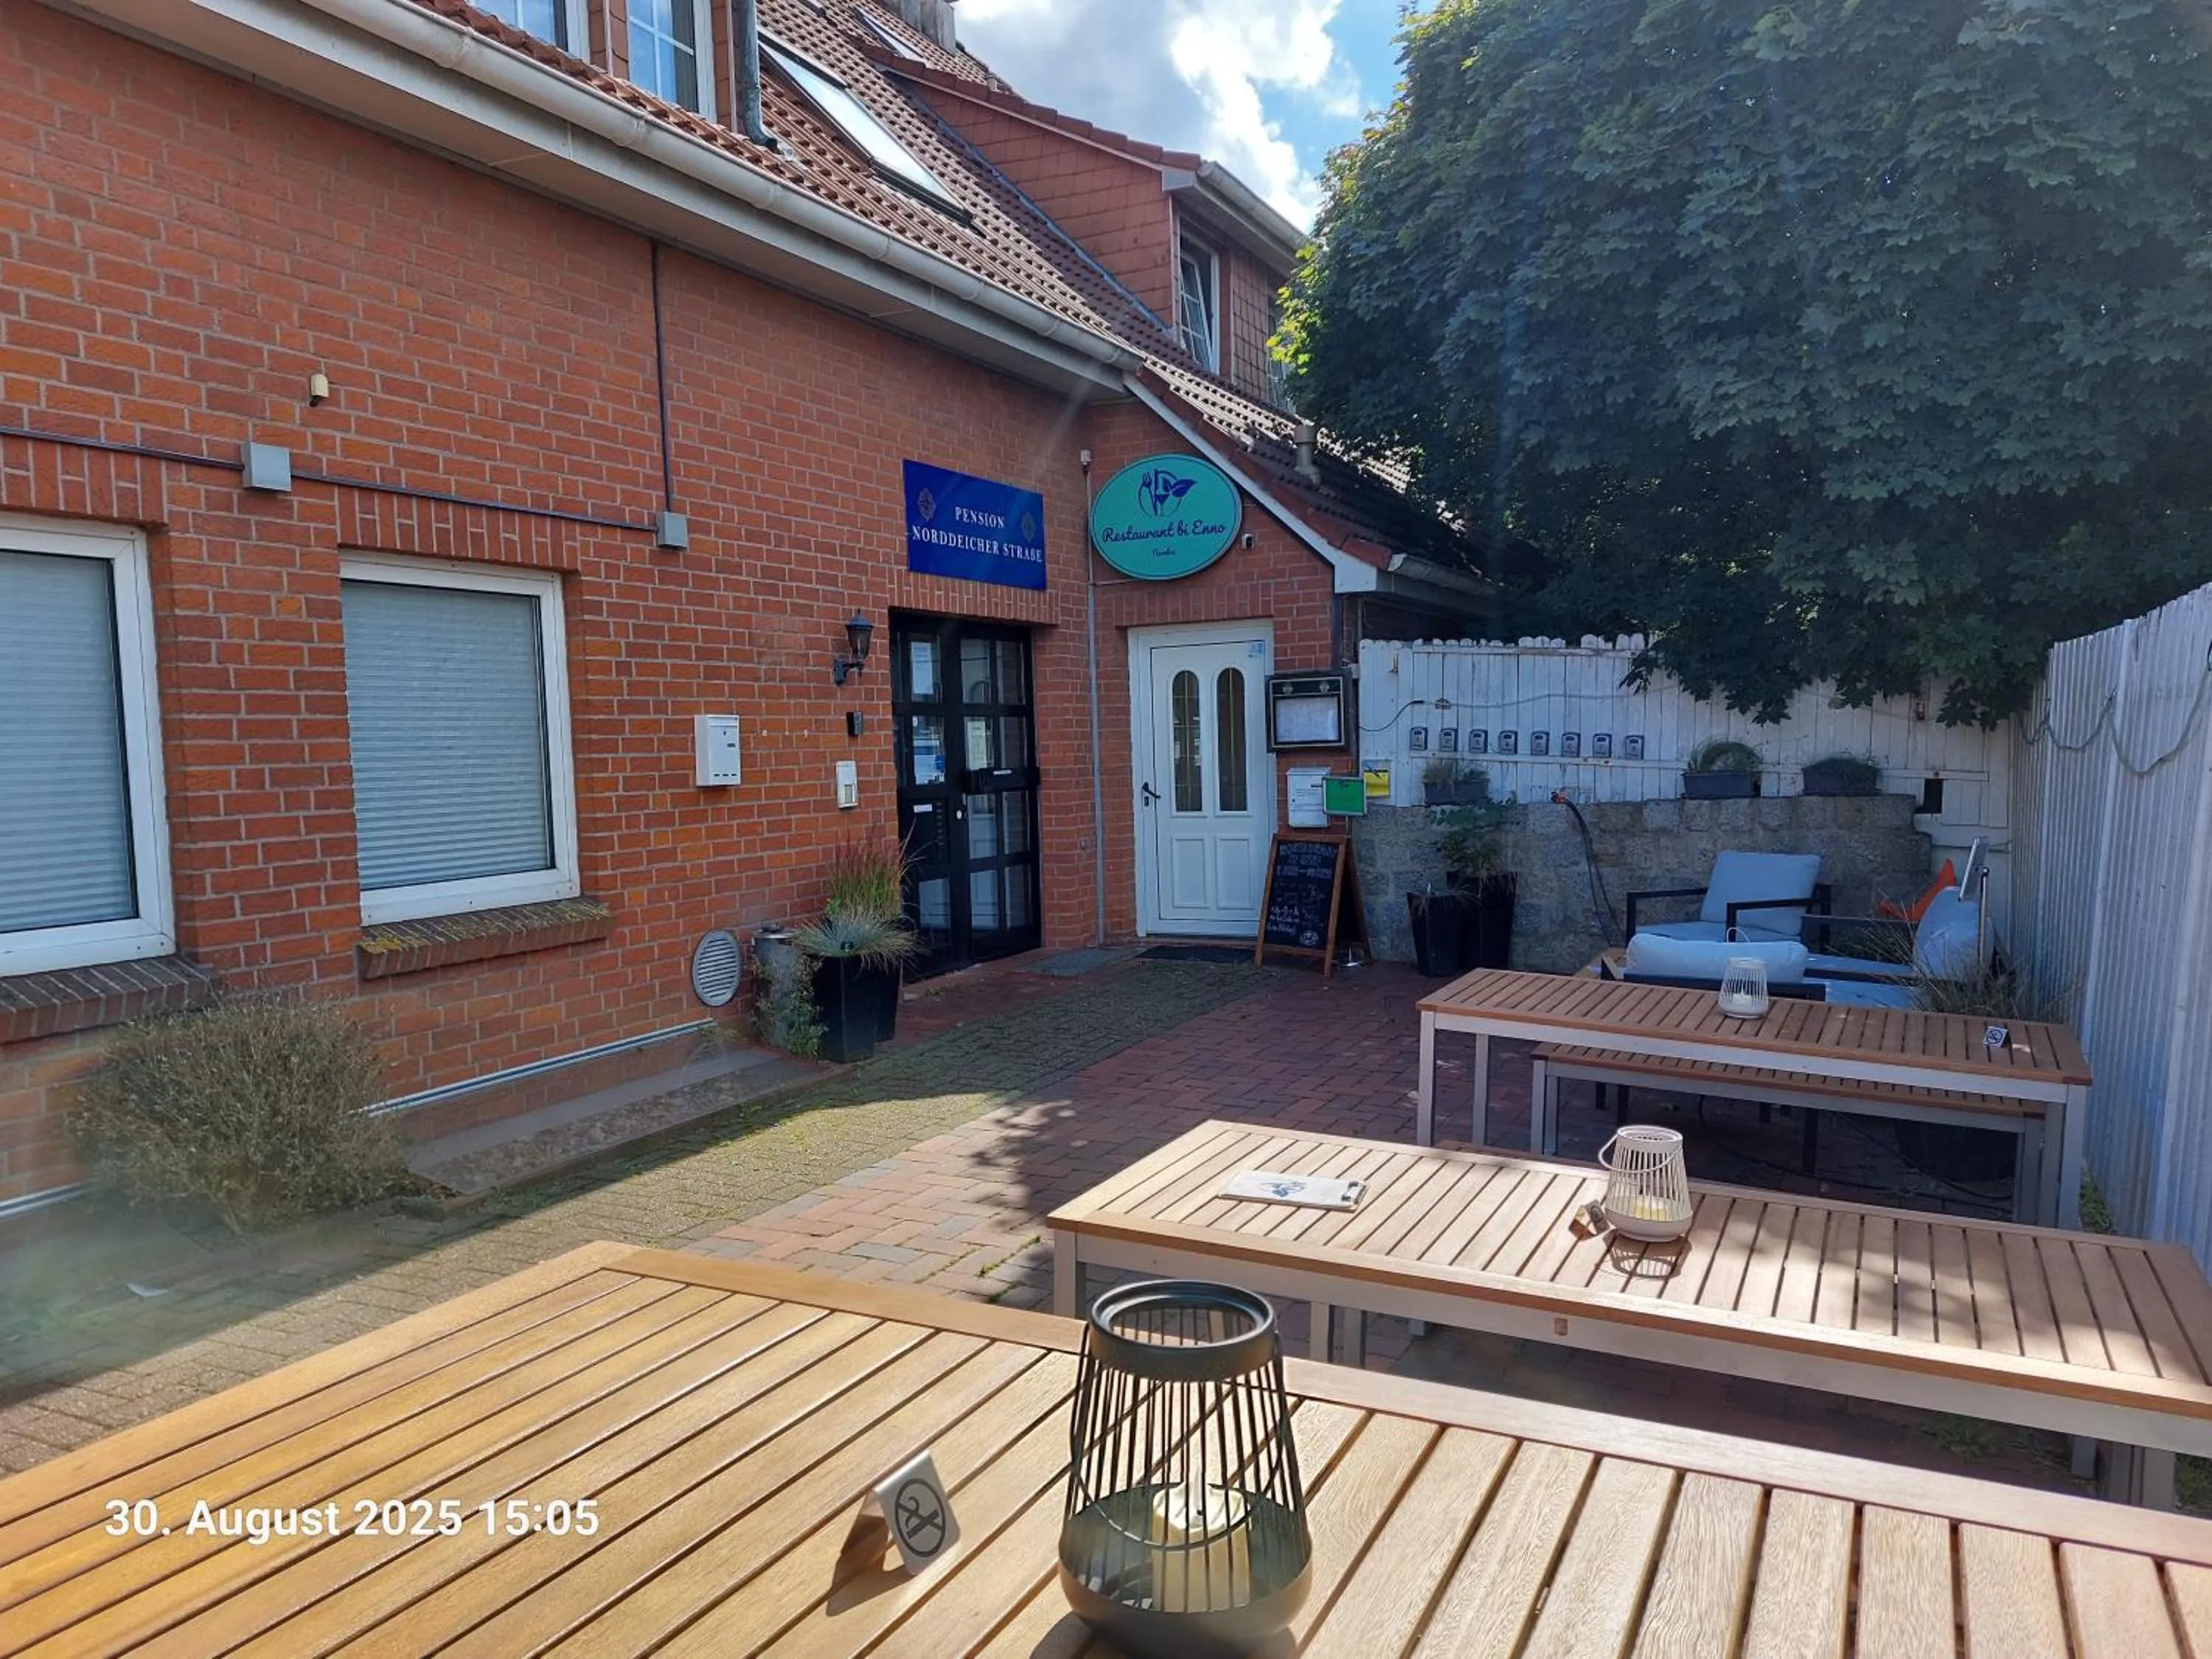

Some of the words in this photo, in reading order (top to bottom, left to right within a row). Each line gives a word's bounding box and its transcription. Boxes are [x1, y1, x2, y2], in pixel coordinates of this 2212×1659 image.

[955, 507, 1004, 529] PENSION
[912, 525, 999, 555] NORDDEICHER
[1102, 524, 1175, 543] Restaurant
[1178, 520, 1189, 535] bi
[1192, 519, 1225, 535] Enno
